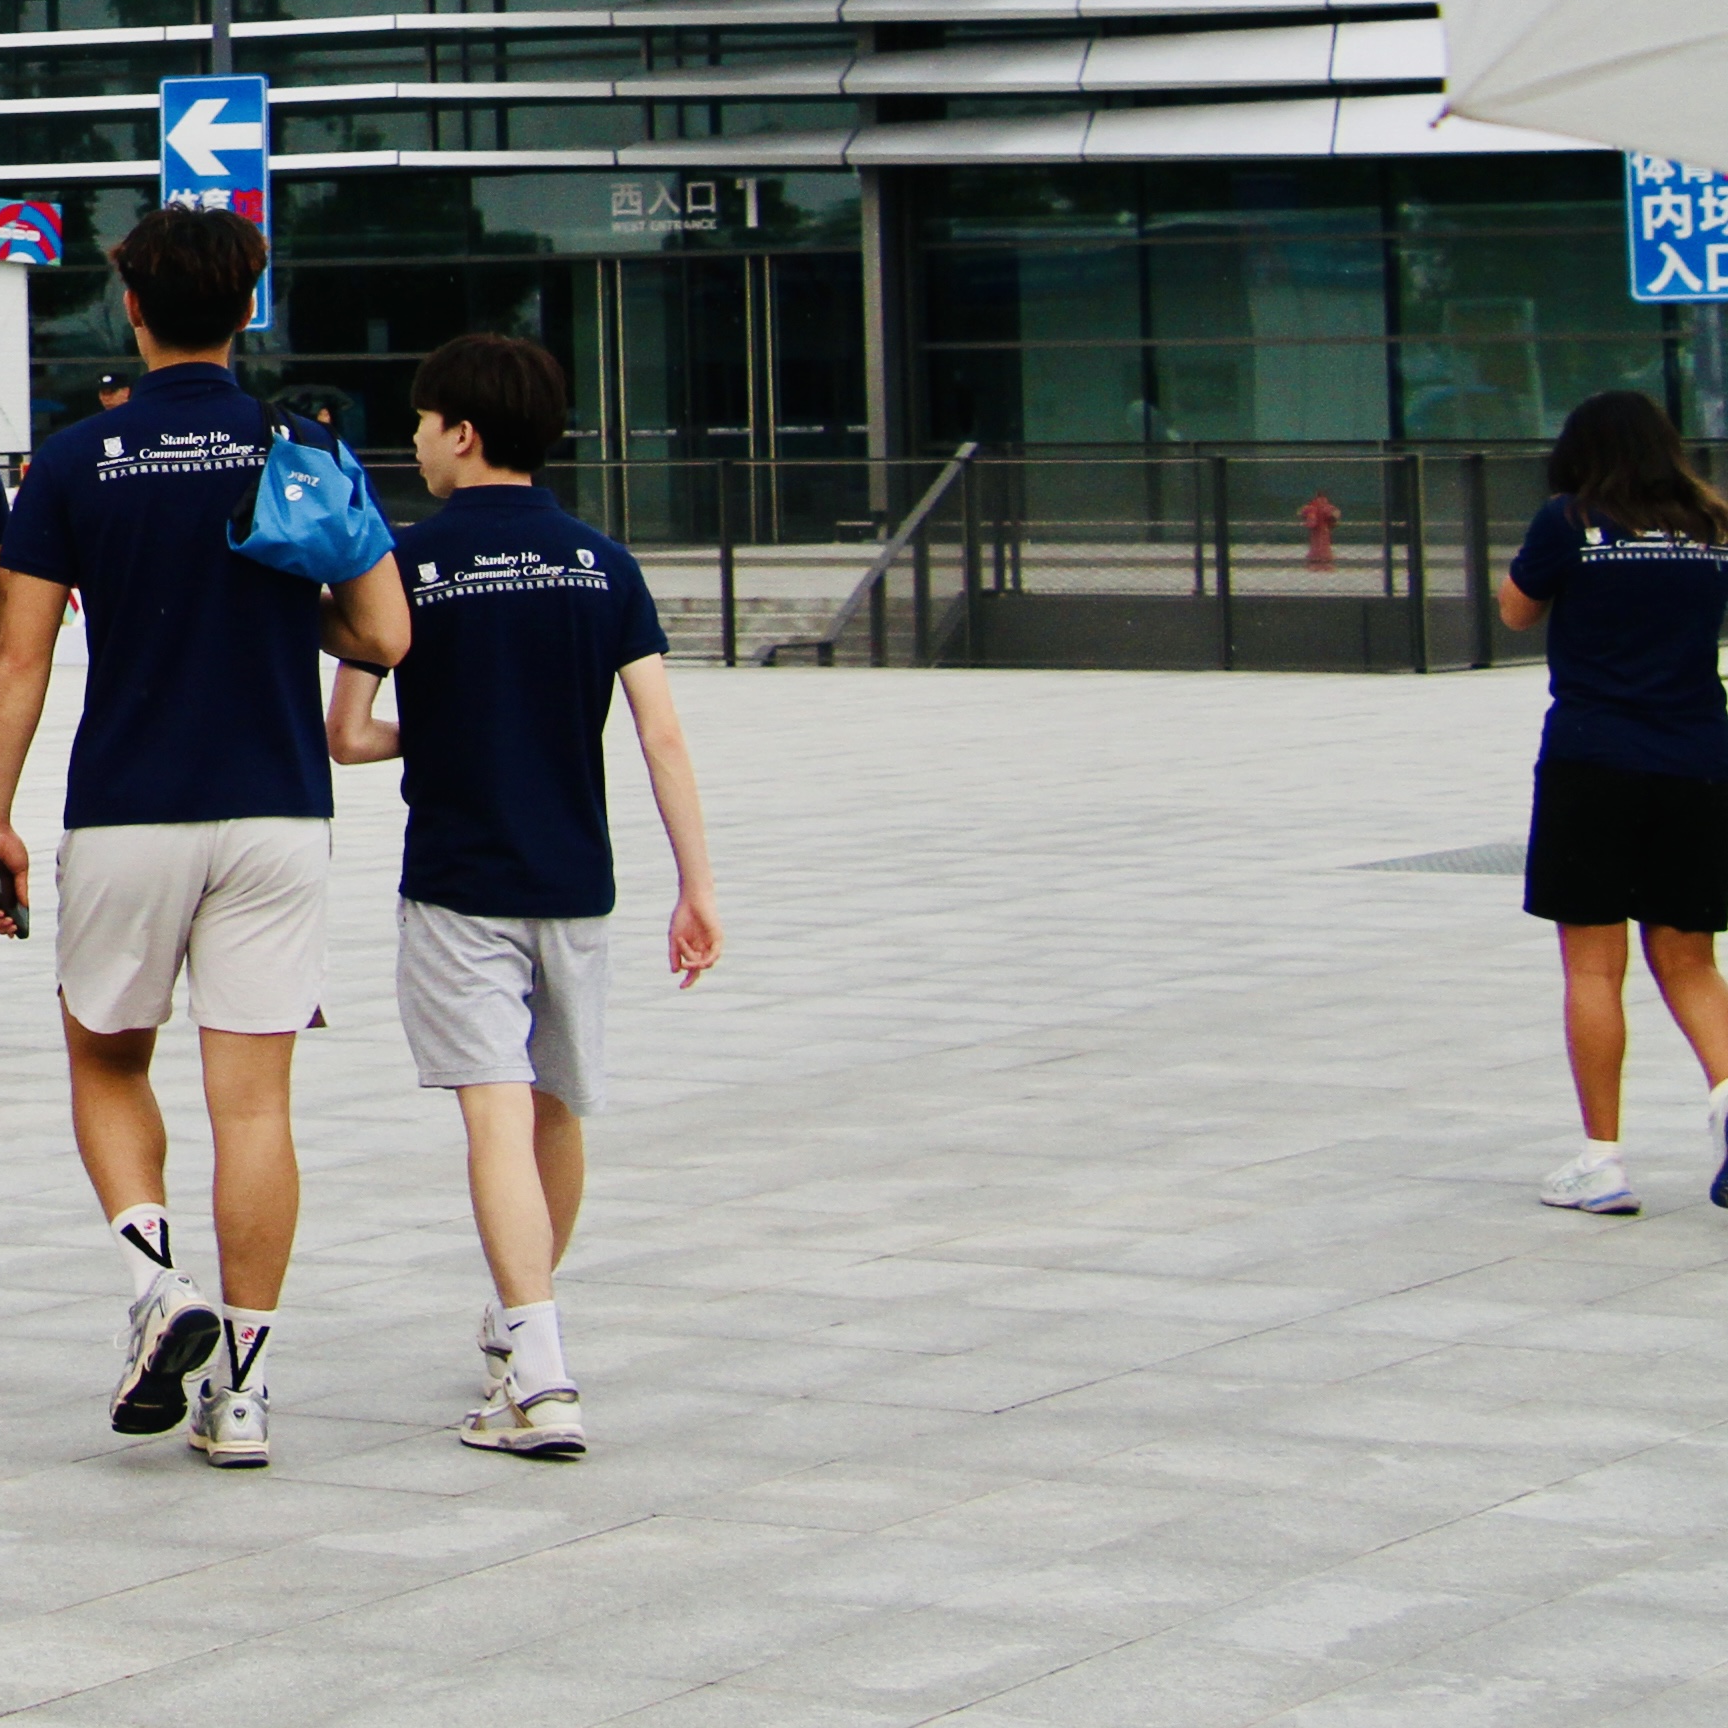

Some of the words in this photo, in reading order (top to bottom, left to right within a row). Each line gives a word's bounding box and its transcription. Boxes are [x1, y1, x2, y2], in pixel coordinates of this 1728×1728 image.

[610, 181, 717, 217] 西入口
[735, 178, 758, 228] 1
[160, 433, 207, 447] Stanley
[209, 431, 230, 443] Ho
[139, 446, 209, 462] Community
[211, 442, 254, 457] College
[474, 552, 519, 567] Stanley
[520, 552, 541, 563] Ho
[454, 567, 521, 582] Community
[522, 564, 564, 578] College
